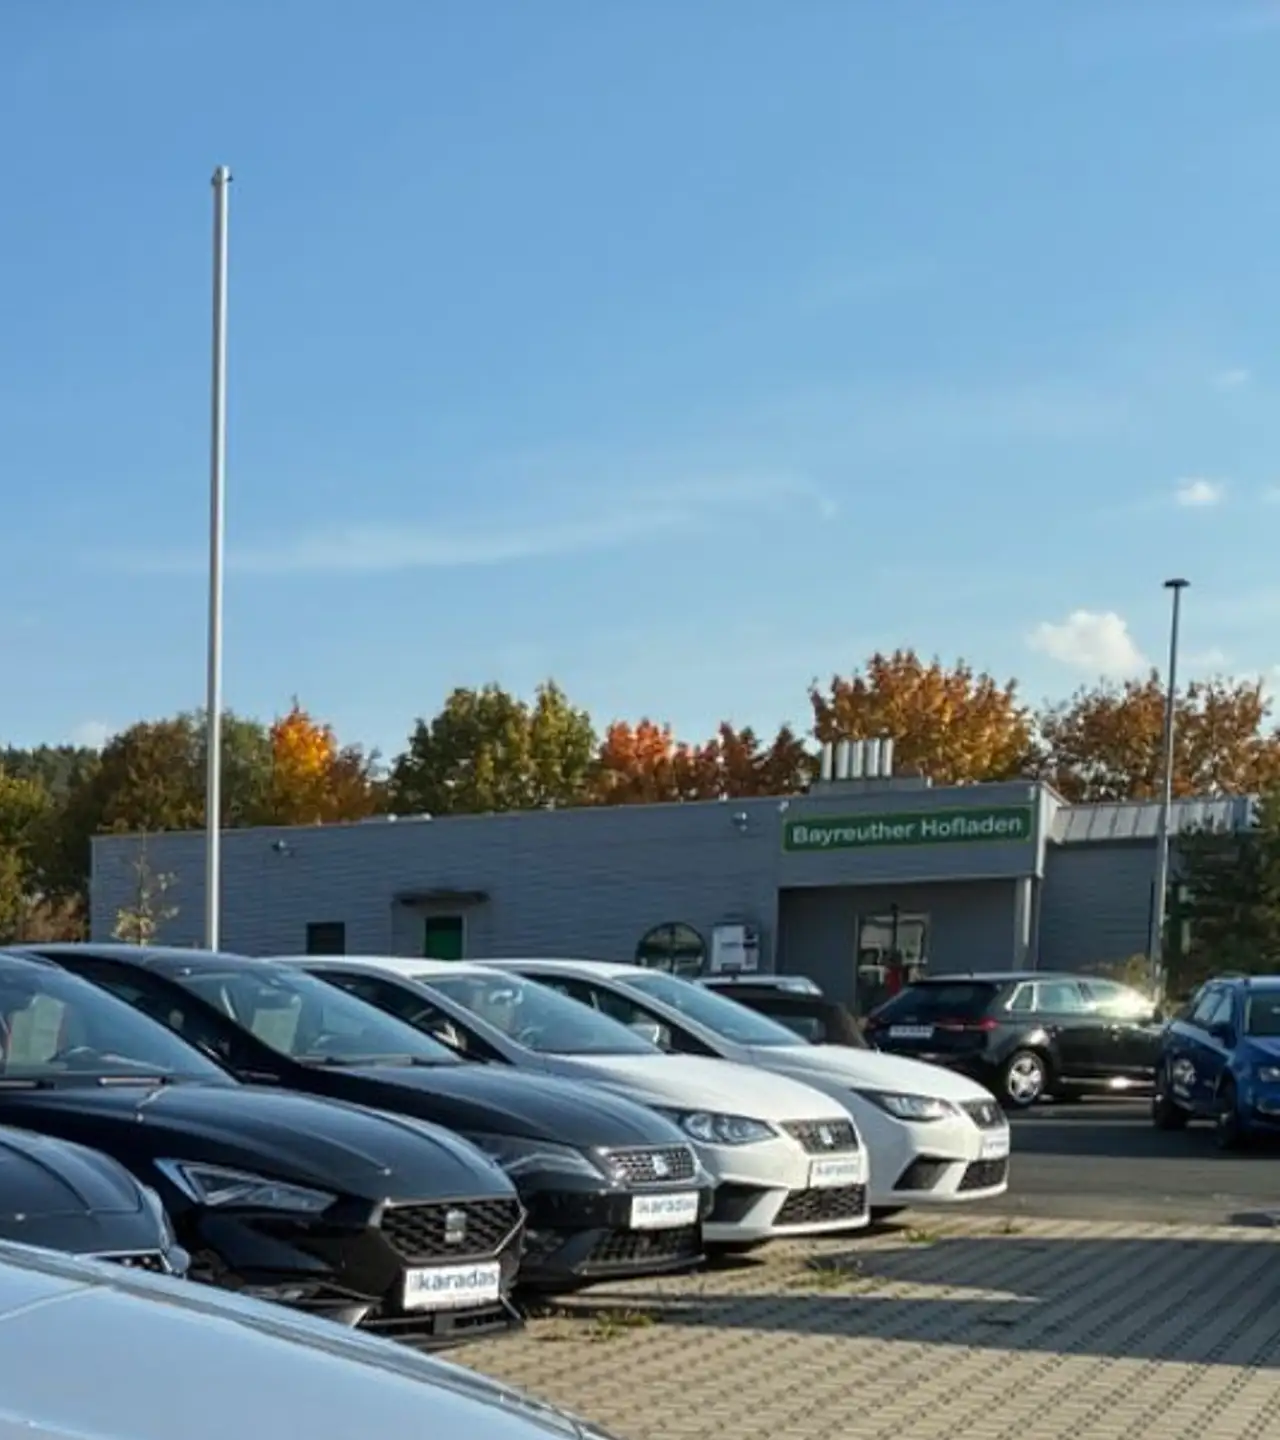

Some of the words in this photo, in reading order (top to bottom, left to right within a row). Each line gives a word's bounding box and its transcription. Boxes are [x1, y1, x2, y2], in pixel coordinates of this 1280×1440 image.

[793, 822, 915, 846] Bayreuther
[921, 816, 1022, 837] Hofladen
[419, 1268, 496, 1292] karadas
